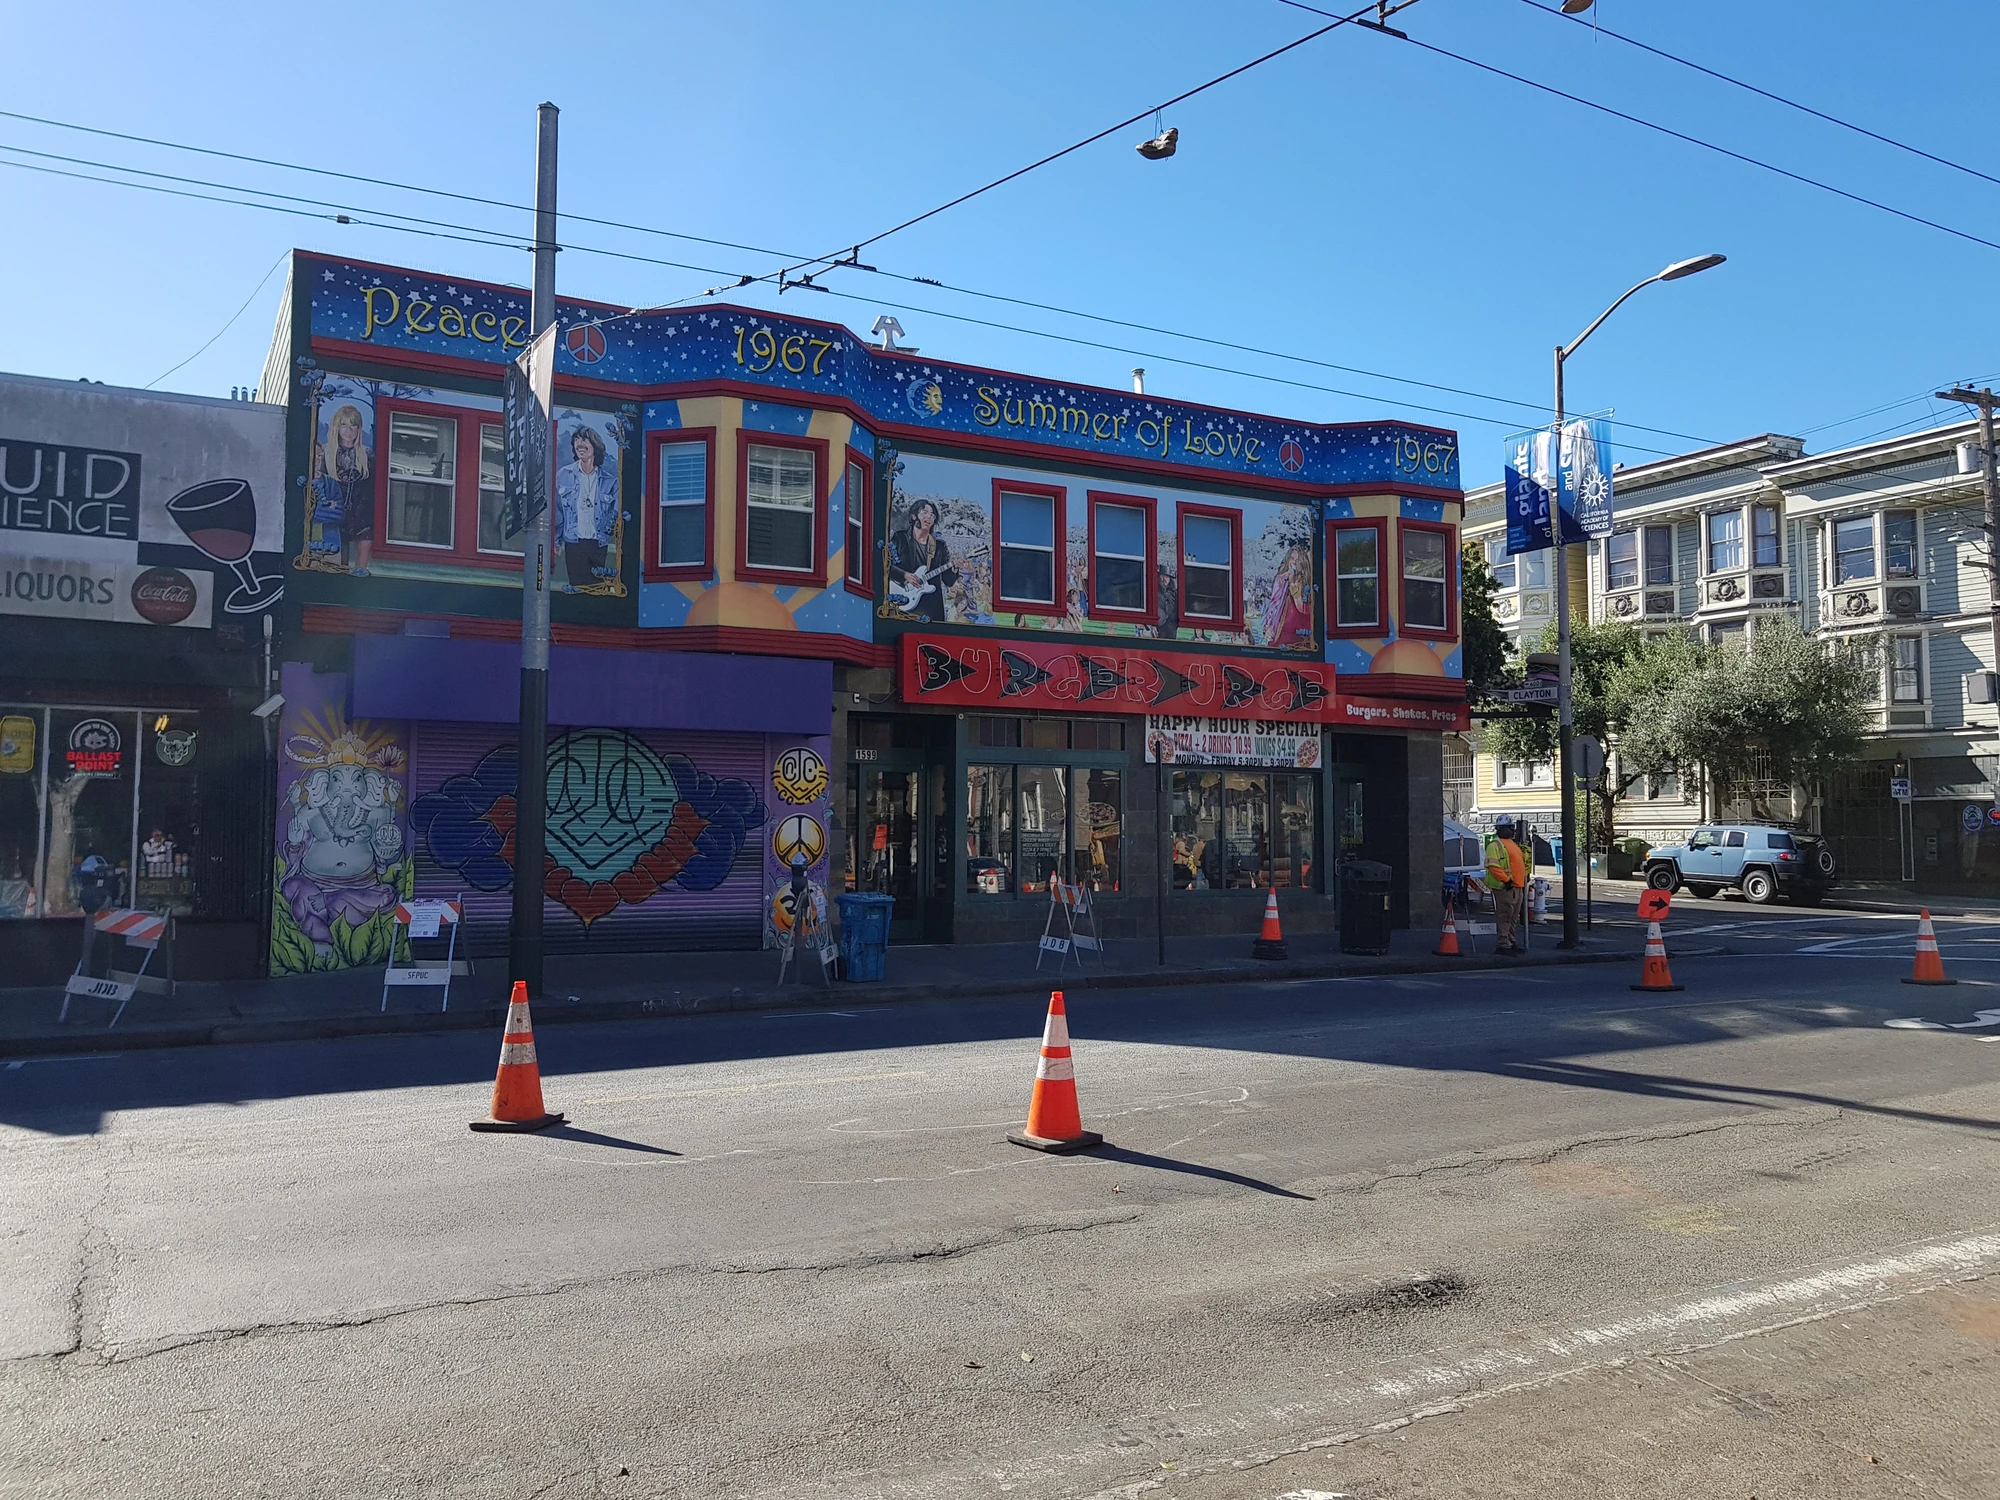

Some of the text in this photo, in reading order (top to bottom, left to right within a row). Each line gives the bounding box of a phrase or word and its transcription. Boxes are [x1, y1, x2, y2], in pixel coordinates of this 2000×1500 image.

[360, 286, 529, 351] Peace
[733, 327, 832, 377] 1967
[974, 386, 1262, 464] Summer of Love
[1393, 437, 1456, 474] 1967
[1580, 509, 1609, 519] CALIFORNIA
[1580, 516, 1603, 525] ACADEMY
[1580, 521, 1609, 532] SCIENCES
[0, 571, 114, 605] IQUORS
[917, 643, 1324, 711] BURGER URGE
[1513, 689, 1551, 699] CLAYTON
[1150, 714, 1319, 738] HAPPY HOUR SPECIAL
[1173, 733, 1193, 752] PIZZA
[1202, 735, 1208, 752] 2
[1208, 735, 1232, 754] DRINKS
[1233, 735, 1252, 755] 10.99
[1254, 737, 1277, 756] WINGS
[1277, 738, 1296, 757] $4.99
[66, 751, 122, 761] BALLAST
[856, 750, 877, 760] 1599
[1175, 753, 1204, 765] MONDAY
[1211, 755, 1236, 766] FRIDAY
[75, 761, 115, 771] POINT
[407, 971, 429, 980] SFPUC
